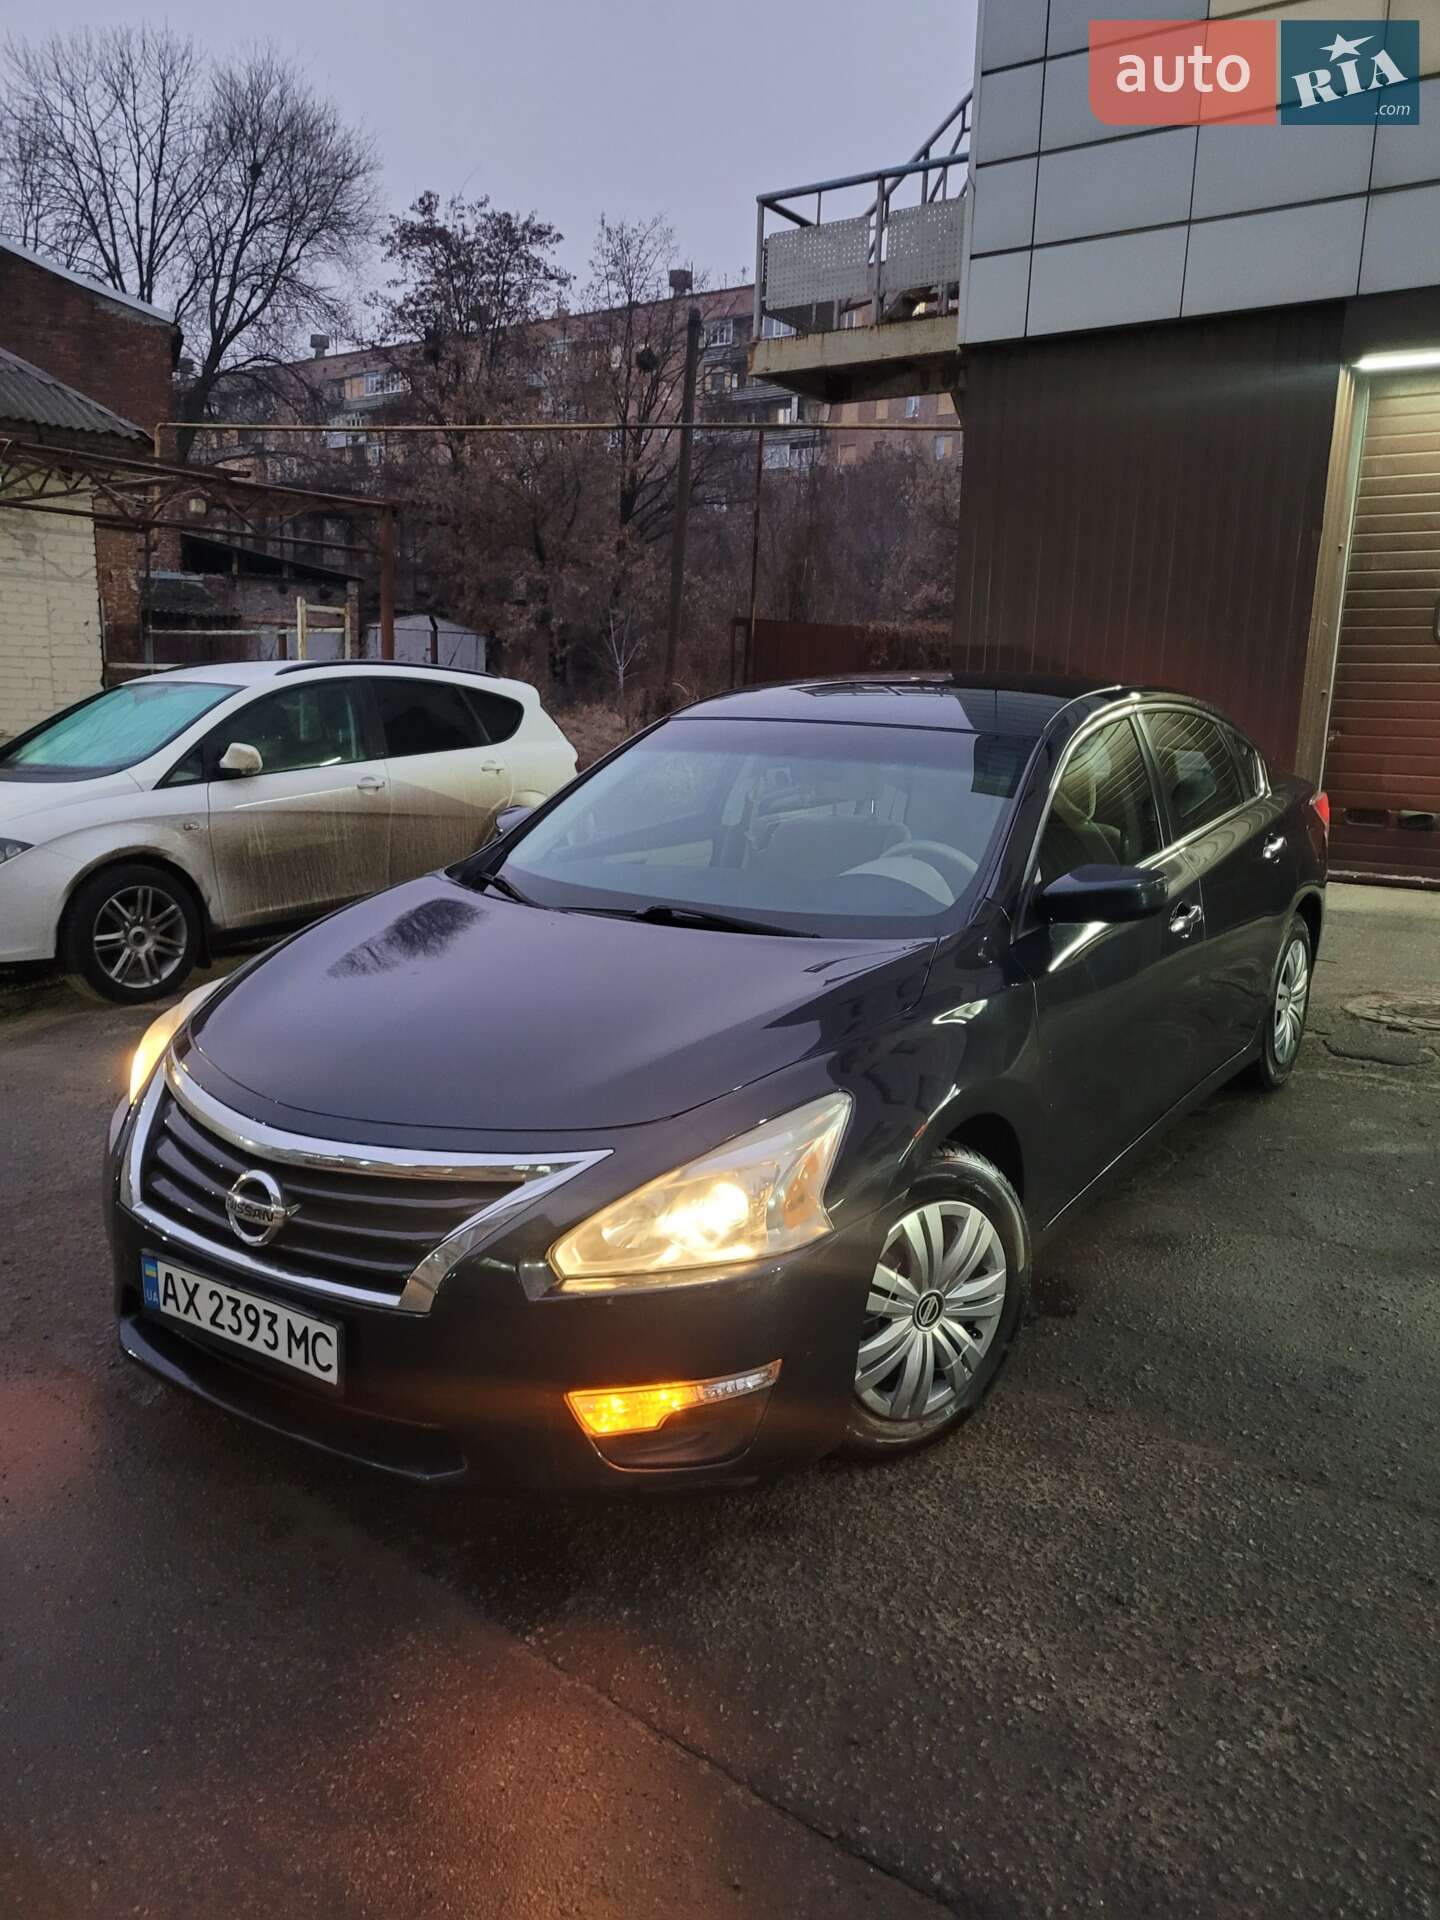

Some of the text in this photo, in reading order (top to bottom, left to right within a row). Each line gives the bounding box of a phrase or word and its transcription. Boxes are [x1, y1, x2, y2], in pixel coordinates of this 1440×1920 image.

[227, 1197, 275, 1222] NISSAN
[146, 1287, 160, 1304] UA
[162, 1272, 333, 1372] AX 2393 MC
